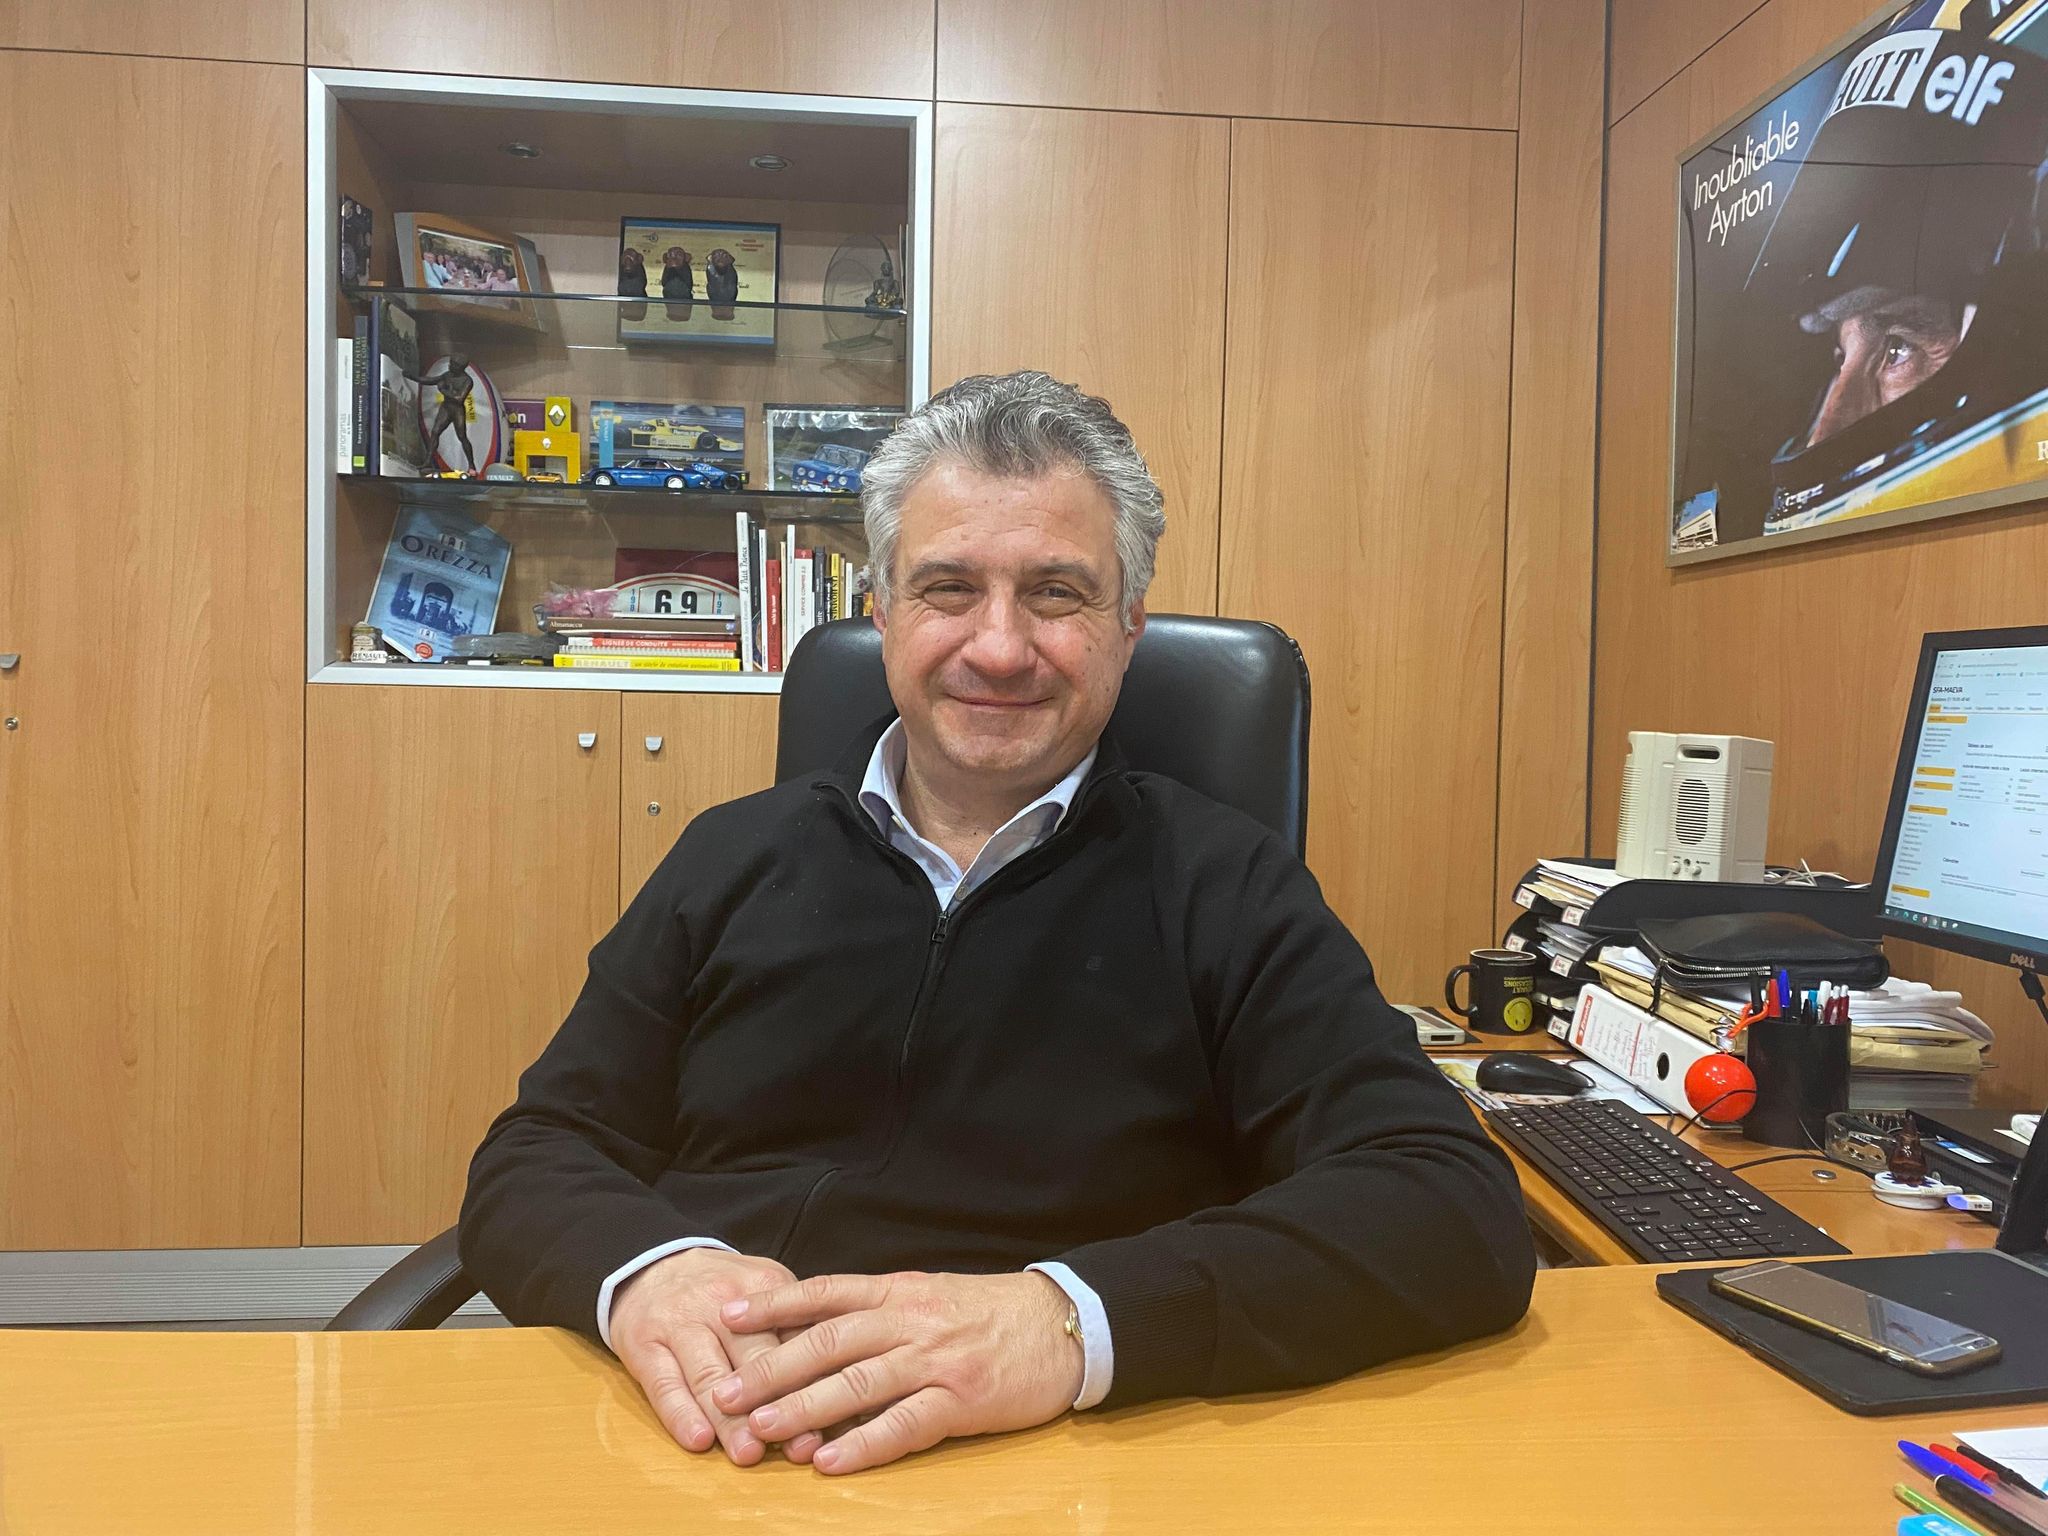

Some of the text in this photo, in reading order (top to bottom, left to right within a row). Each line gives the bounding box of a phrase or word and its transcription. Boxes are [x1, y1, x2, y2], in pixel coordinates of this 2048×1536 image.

[1925, 54, 2015, 126] elf
[1693, 110, 1800, 211] Inoubliable
[1707, 181, 1773, 247] Ayrton
[400, 534, 492, 579] OREZZA
[576, 659, 629, 668] RENAULT
[602, 639, 625, 647] LIGNES
[635, 640, 668, 648] CONDUITE
[2009, 953, 2035, 969] DELL
